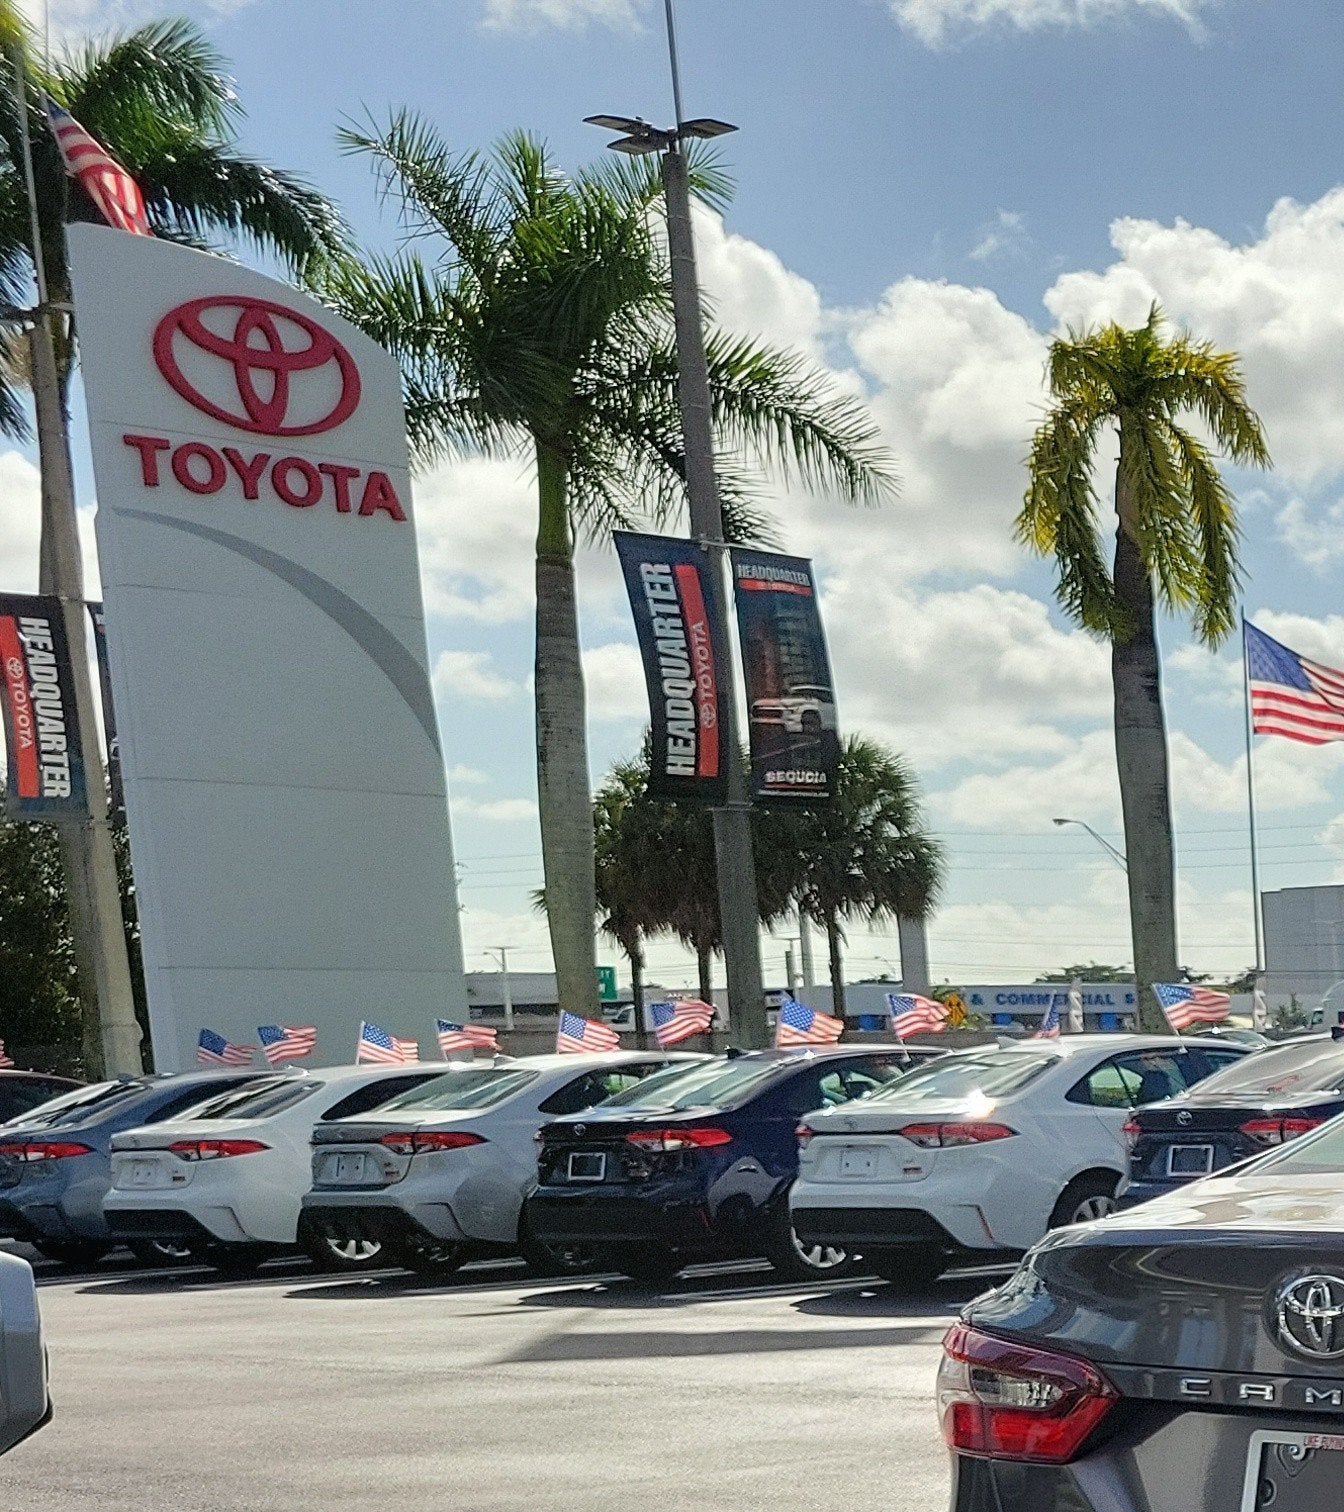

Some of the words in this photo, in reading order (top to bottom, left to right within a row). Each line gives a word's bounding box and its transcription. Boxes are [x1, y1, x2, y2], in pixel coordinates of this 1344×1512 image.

[123, 433, 407, 521] TOYOTA
[640, 562, 697, 776] HEADQUARTER
[690, 621, 713, 700] TOYOTA
[12, 681, 33, 749] TOYOTA
[19, 616, 72, 798] HEADQUARTER
[996, 993, 1114, 1006] COMMEIAL
